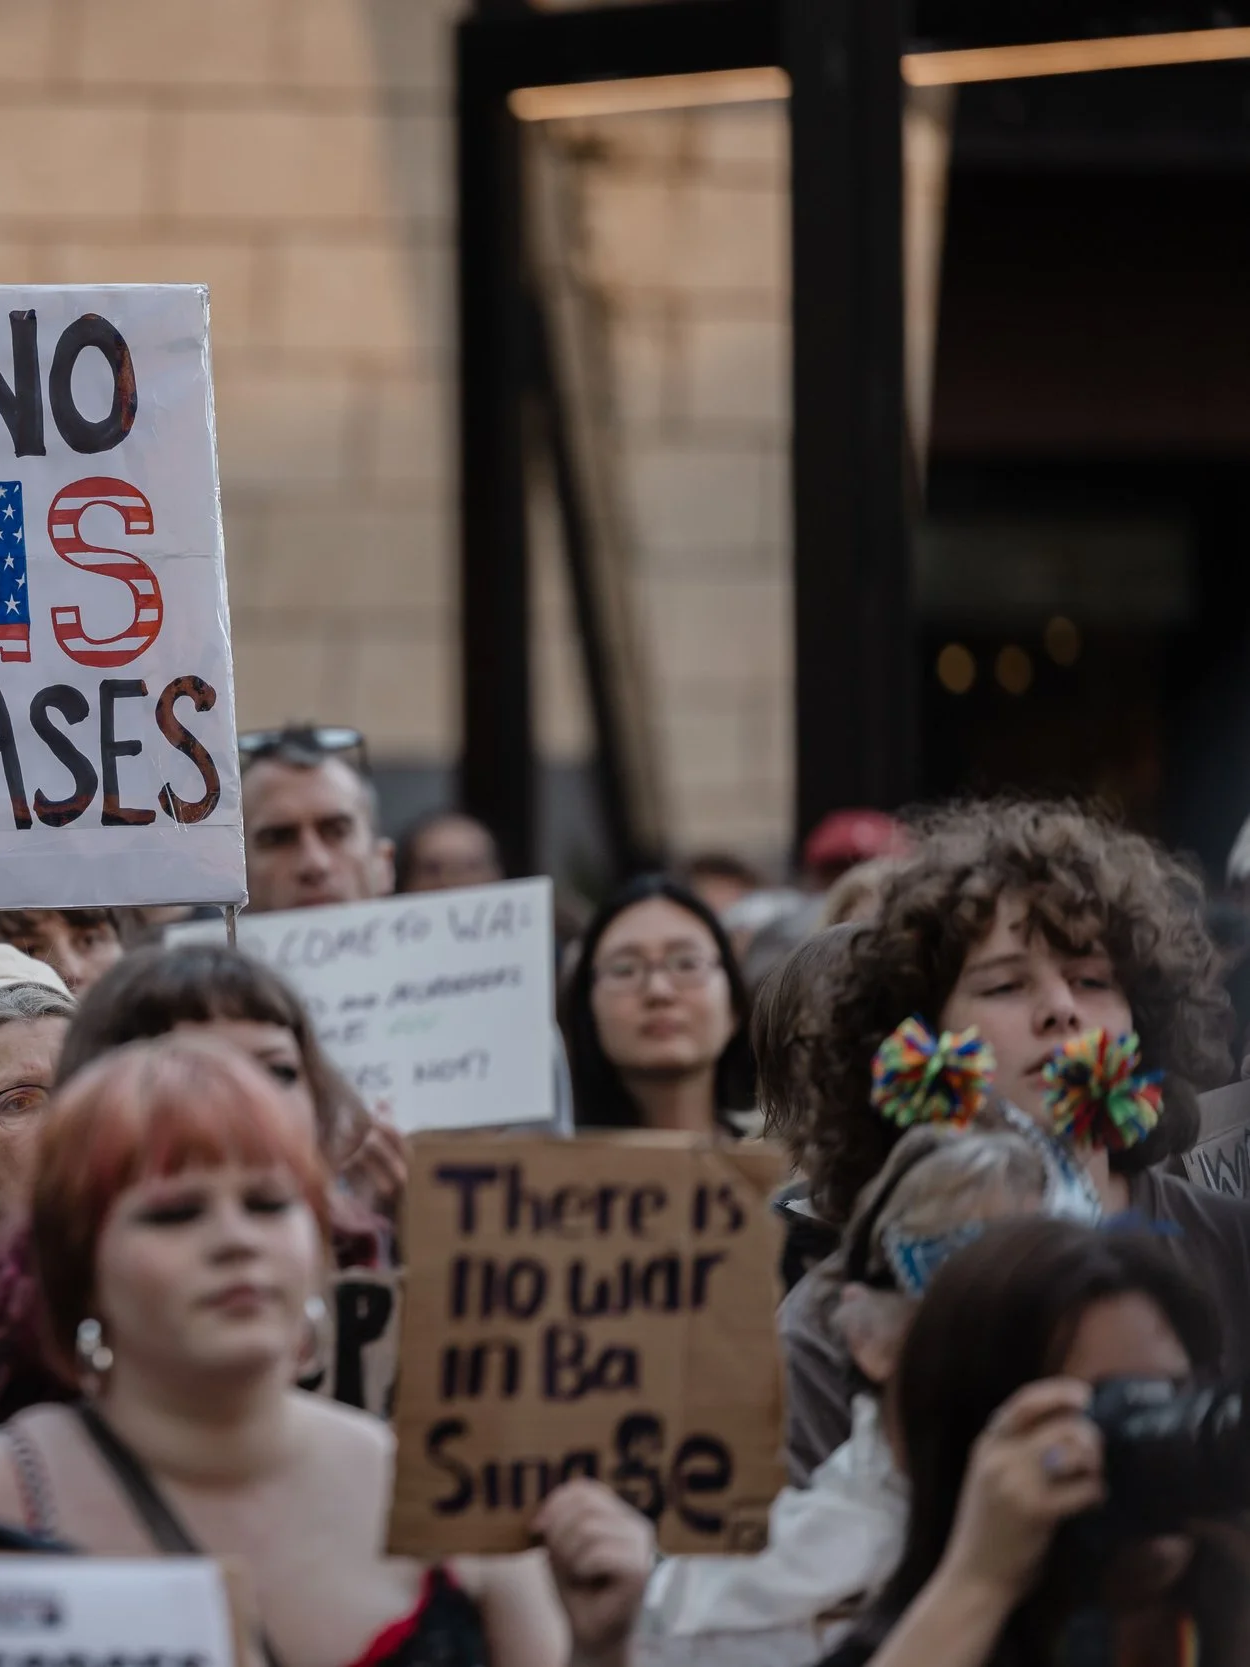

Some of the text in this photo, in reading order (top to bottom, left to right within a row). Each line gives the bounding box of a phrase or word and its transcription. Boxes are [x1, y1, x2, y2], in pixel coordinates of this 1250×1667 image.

[435, 1163, 748, 1238] There is
[450, 1249, 726, 1320] no war
[440, 1322, 643, 1402] in Ba
